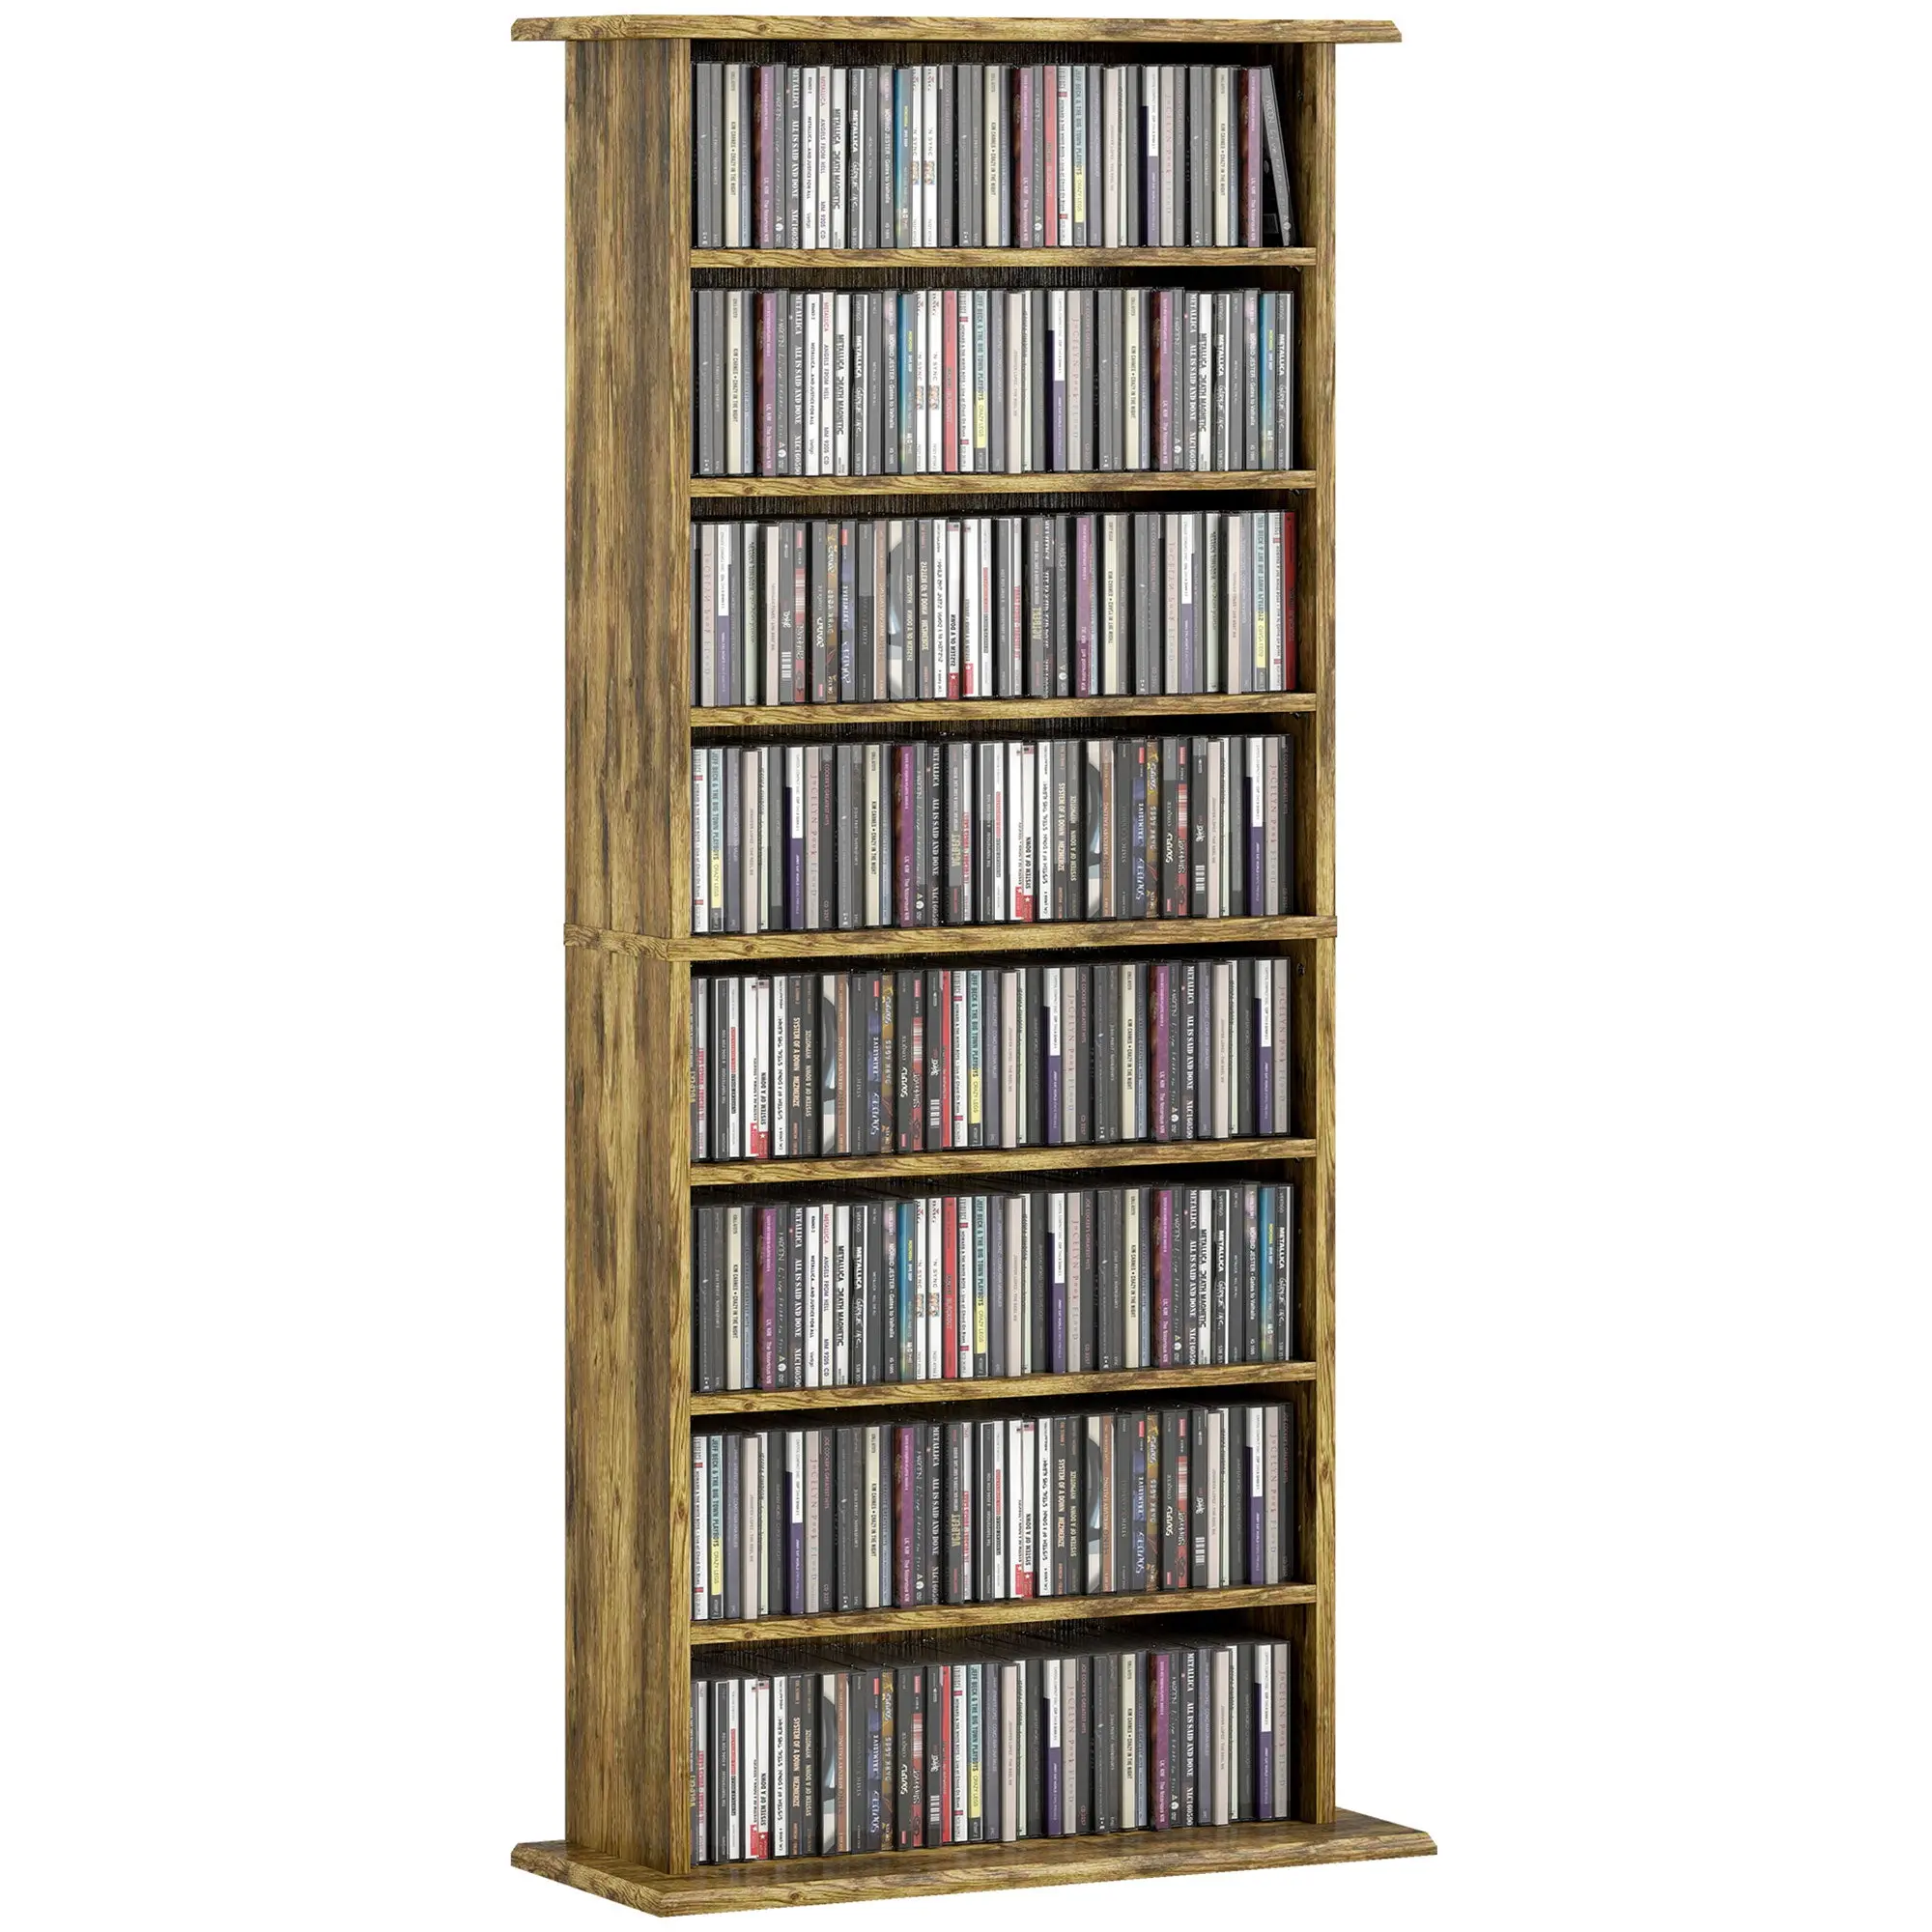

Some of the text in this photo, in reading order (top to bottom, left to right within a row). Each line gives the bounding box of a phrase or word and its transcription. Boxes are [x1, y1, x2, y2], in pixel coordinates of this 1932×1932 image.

[794, 1208, 803, 1248] METALLICA
[794, 1259, 803, 1272] ALL
[794, 1282, 803, 1299] SAID
[794, 1301, 803, 1317] AND
[794, 1318, 803, 1338] DONE
